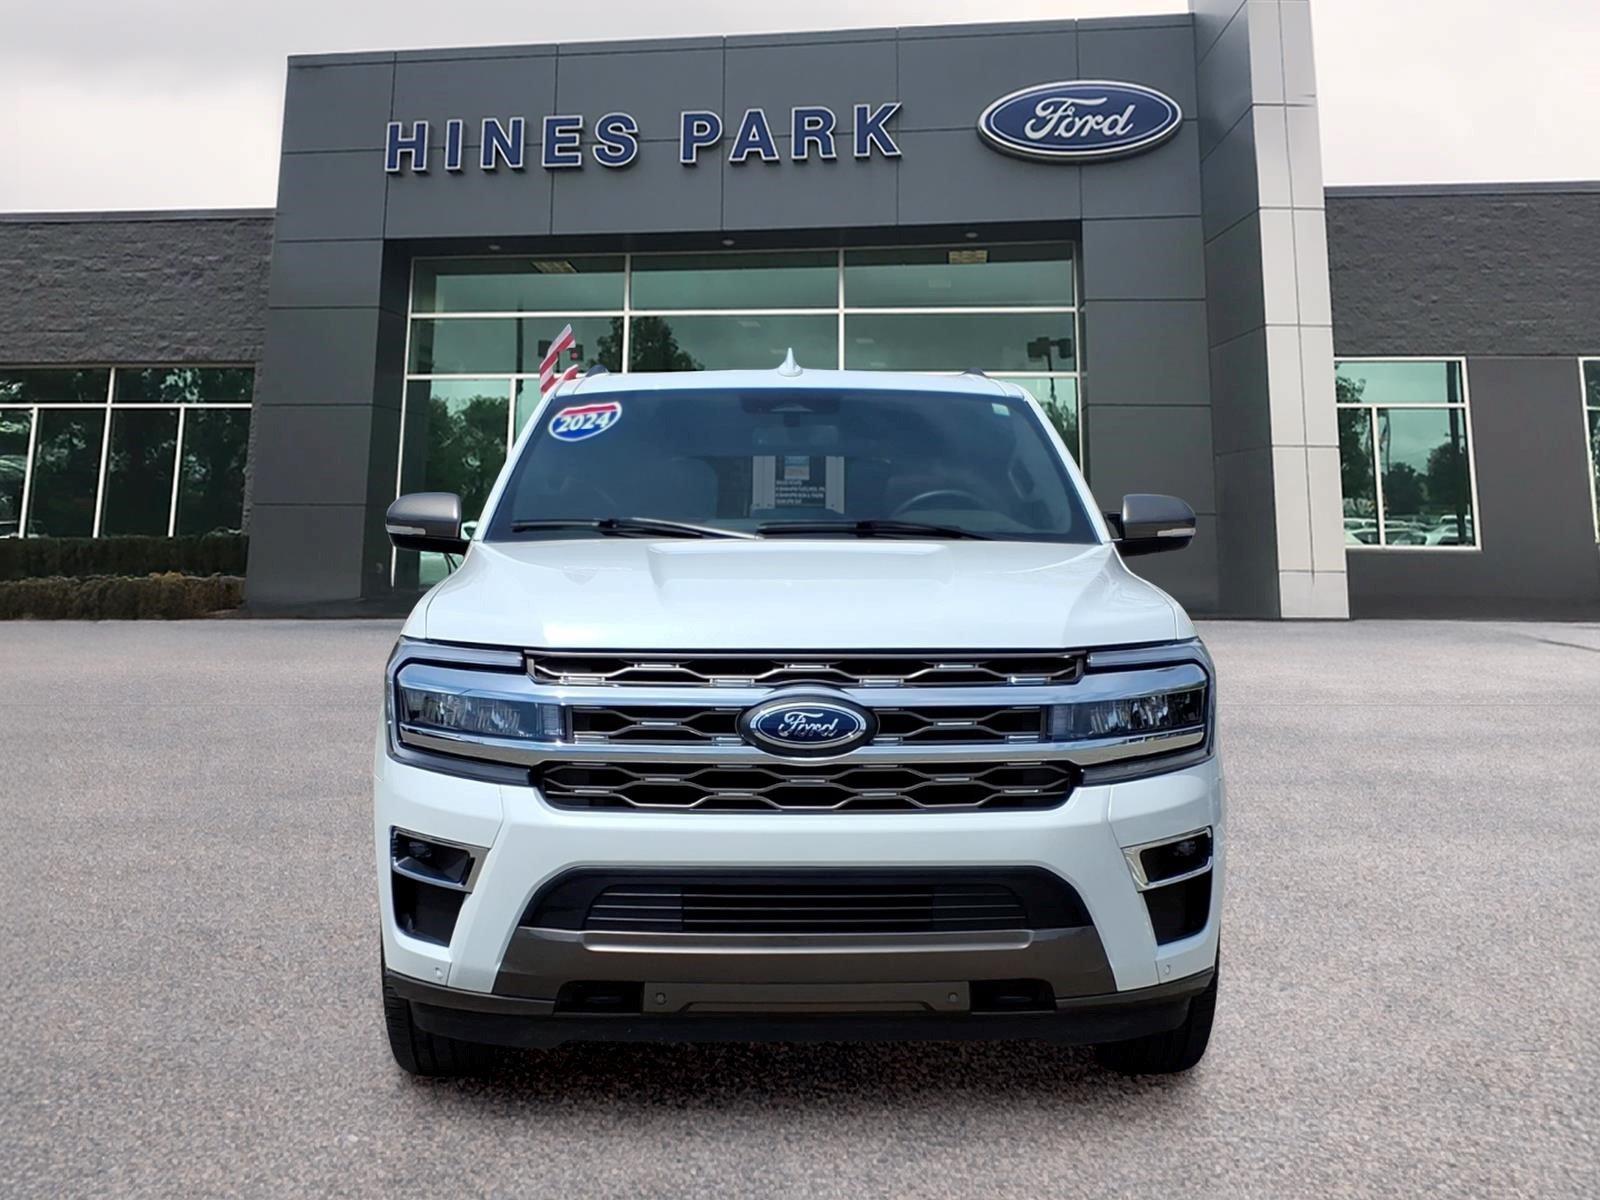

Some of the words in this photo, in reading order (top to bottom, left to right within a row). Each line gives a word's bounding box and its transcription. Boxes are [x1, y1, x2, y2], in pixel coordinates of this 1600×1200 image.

[1024, 97, 1136, 140] Ford
[385, 112, 639, 172] HINES
[680, 102, 902, 163] PARK
[554, 411, 612, 433] 2024
[777, 711, 839, 737] Ford
